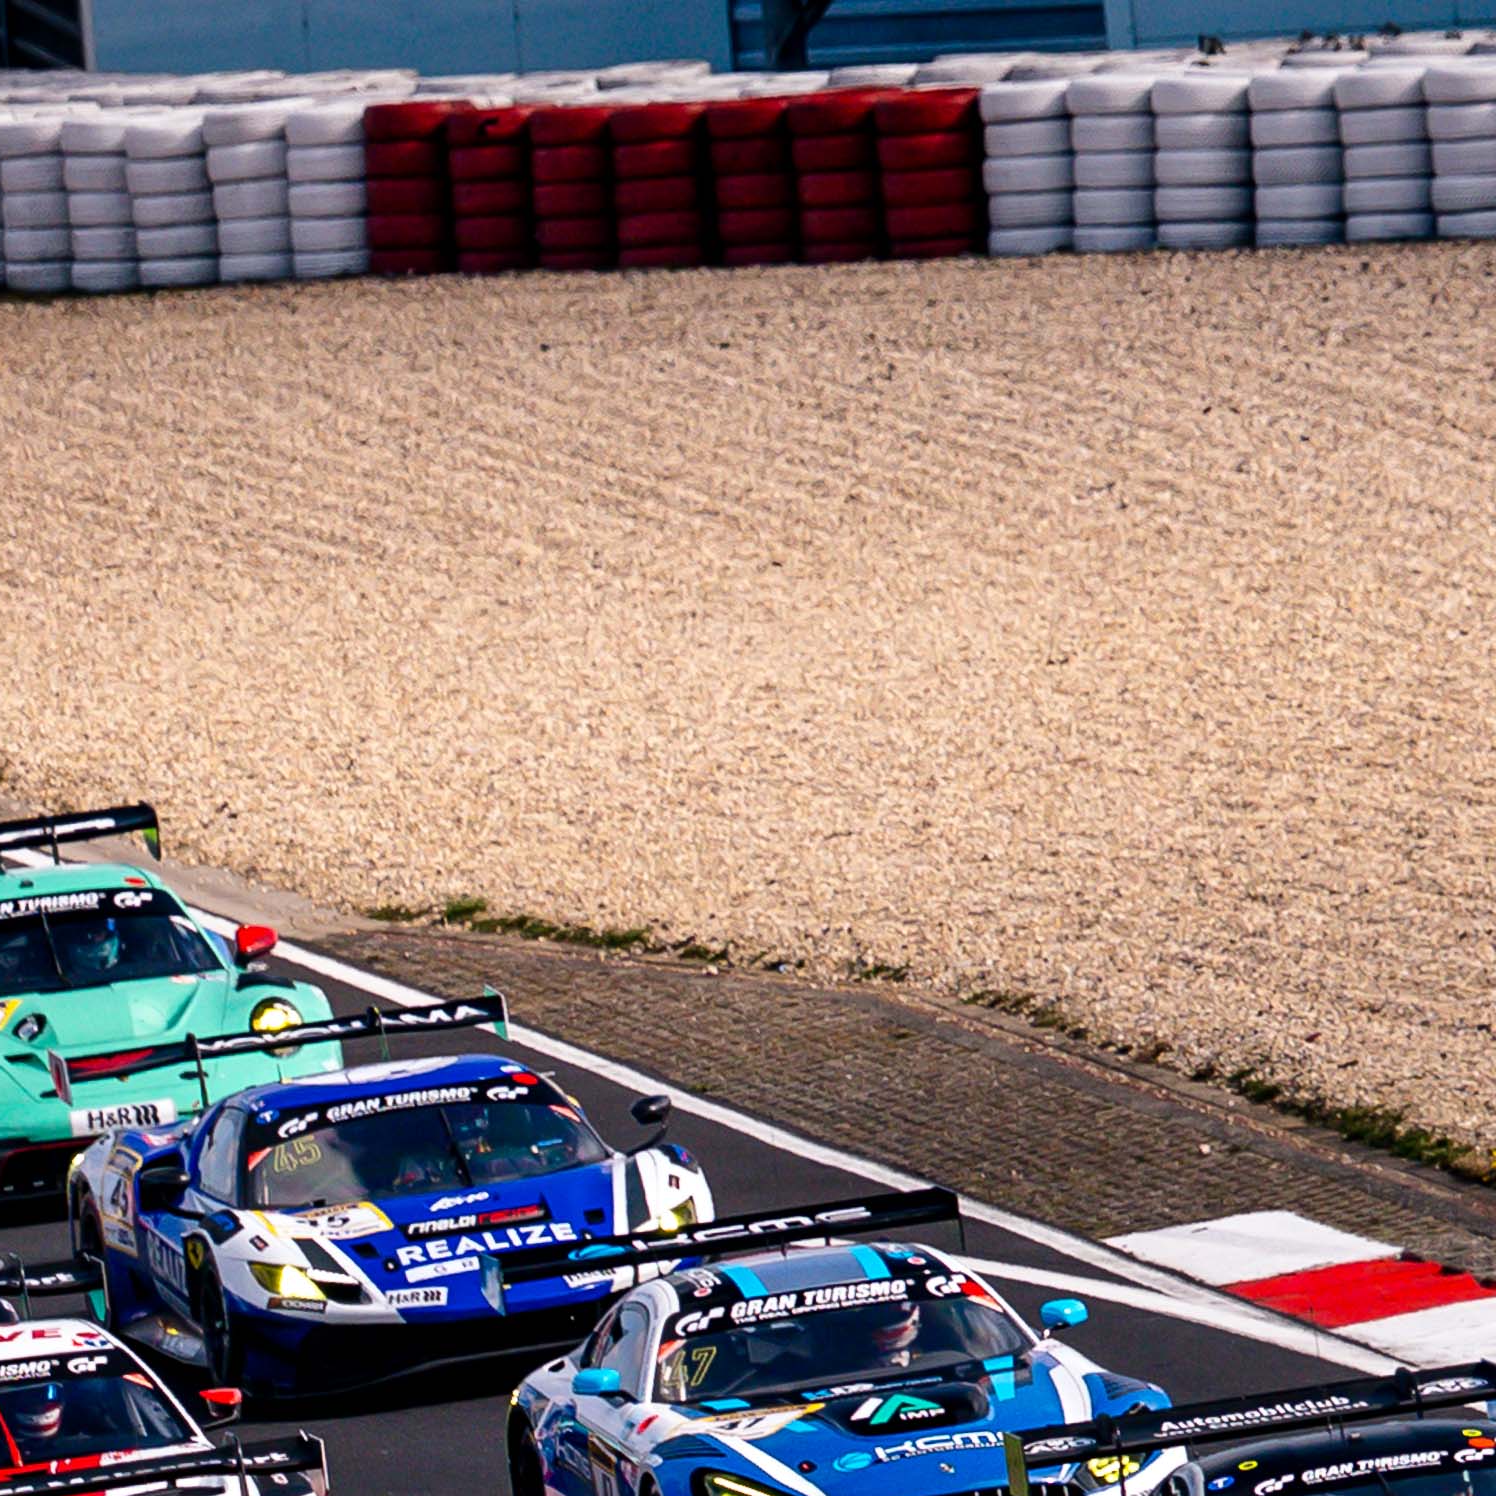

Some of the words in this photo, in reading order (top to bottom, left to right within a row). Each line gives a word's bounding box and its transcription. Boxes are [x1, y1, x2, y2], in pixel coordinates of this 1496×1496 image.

[326, 1096, 381, 1120] GRAN
[383, 1086, 472, 1108] TURISMO
[273, 1134, 321, 1174] 45
[396, 1222, 579, 1267] REALIZE
[730, 1292, 797, 1320] GRAN
[802, 1279, 907, 1307] TURISMO
[1160, 1395, 1351, 1432] Automobilclub
[1301, 1461, 1353, 1483] GRAN
